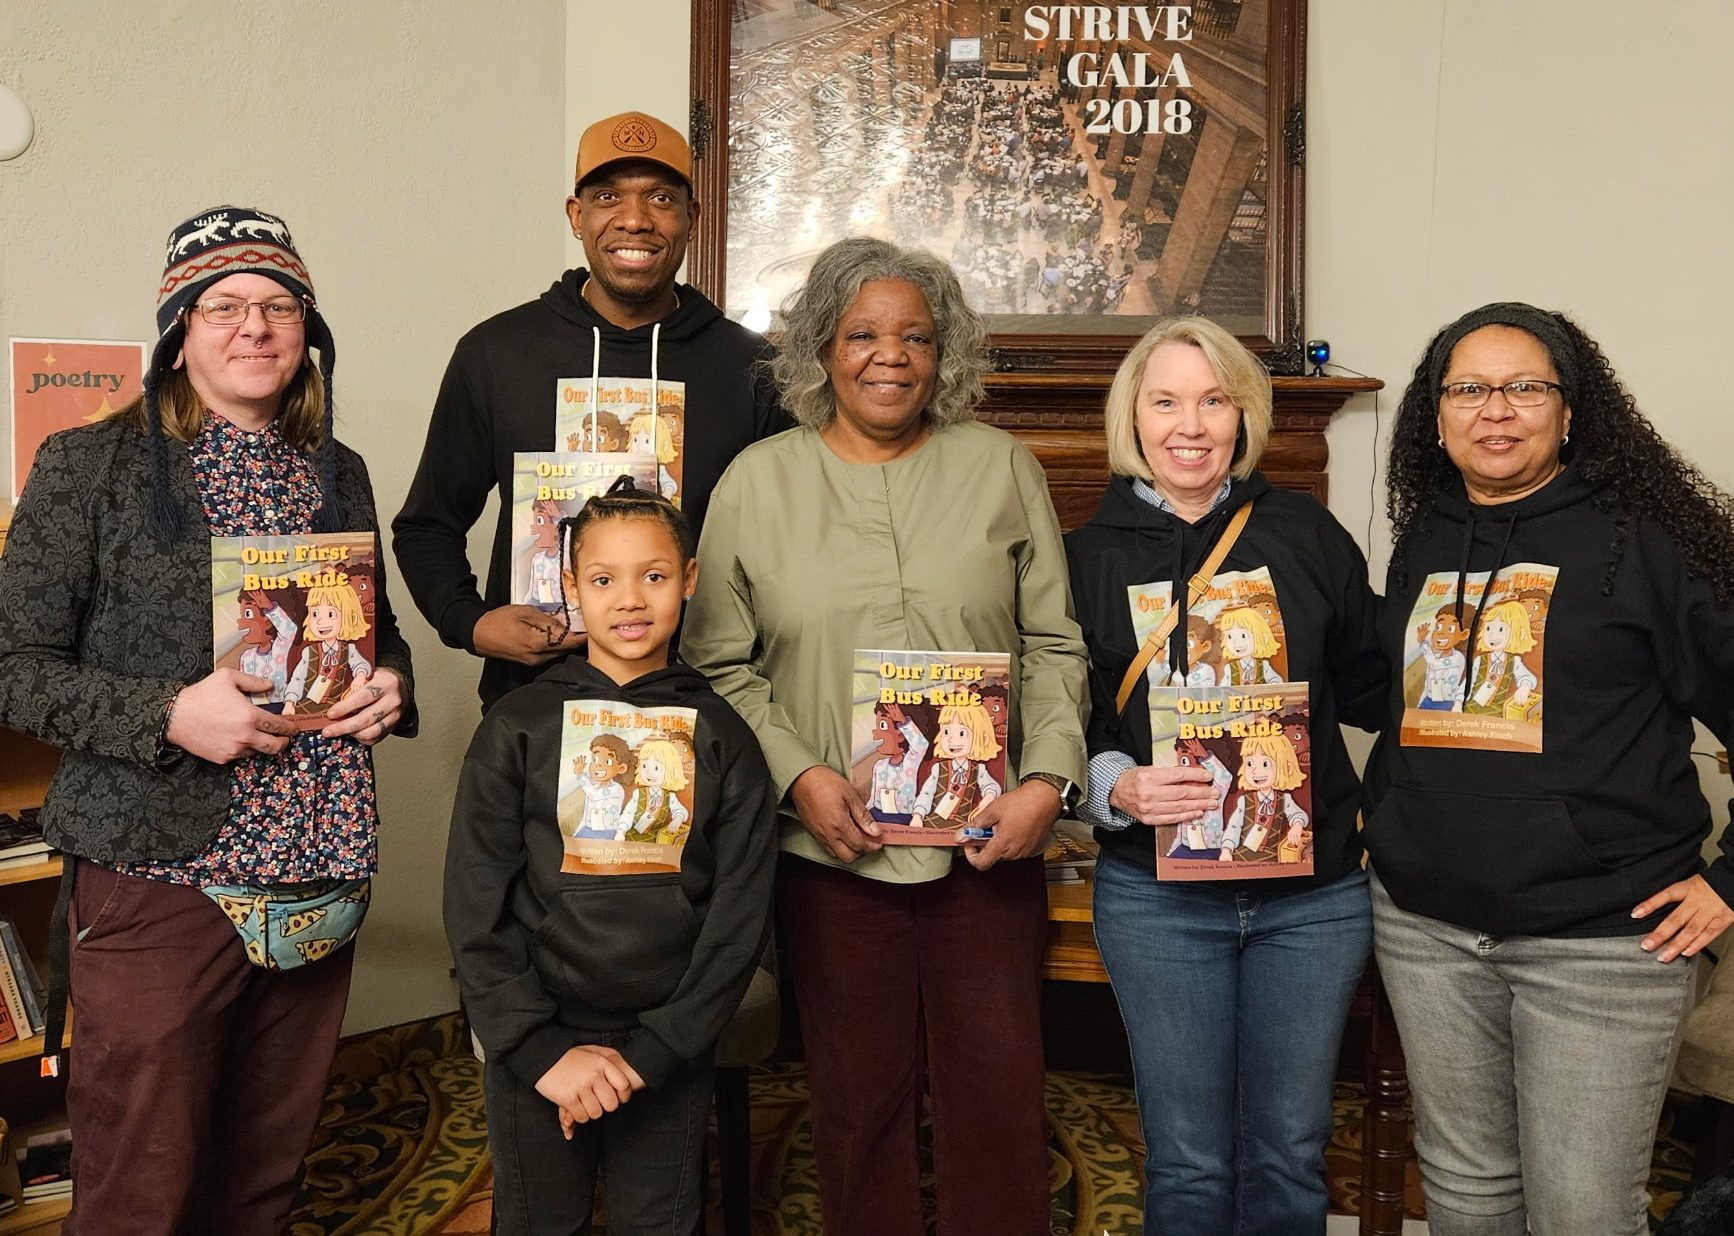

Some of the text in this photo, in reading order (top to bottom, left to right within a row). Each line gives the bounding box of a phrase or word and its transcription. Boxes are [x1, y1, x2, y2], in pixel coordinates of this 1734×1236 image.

[1024, 5, 1193, 41] STRIVE
[1067, 52, 1193, 88] GALA
[1086, 98, 1192, 135] 2018
[25, 369, 126, 394] poetry
[563, 387, 588, 403] Our
[596, 387, 622, 403] irst
[536, 461, 632, 477] Our First
[537, 485, 577, 501] Bus
[241, 544, 350, 565] Our First
[243, 569, 350, 591] Bus Ride
[1136, 593, 1166, 613] Our
[879, 662, 985, 682] Our First
[879, 687, 982, 707] Bus Ride
[1177, 694, 1284, 714] Our First
[569, 708, 597, 726] Our
[599, 709, 630, 729] First
[633, 712, 657, 729] Bus
[1457, 720, 1481, 729] Derek
[1179, 720, 1284, 740] Bus Ride
